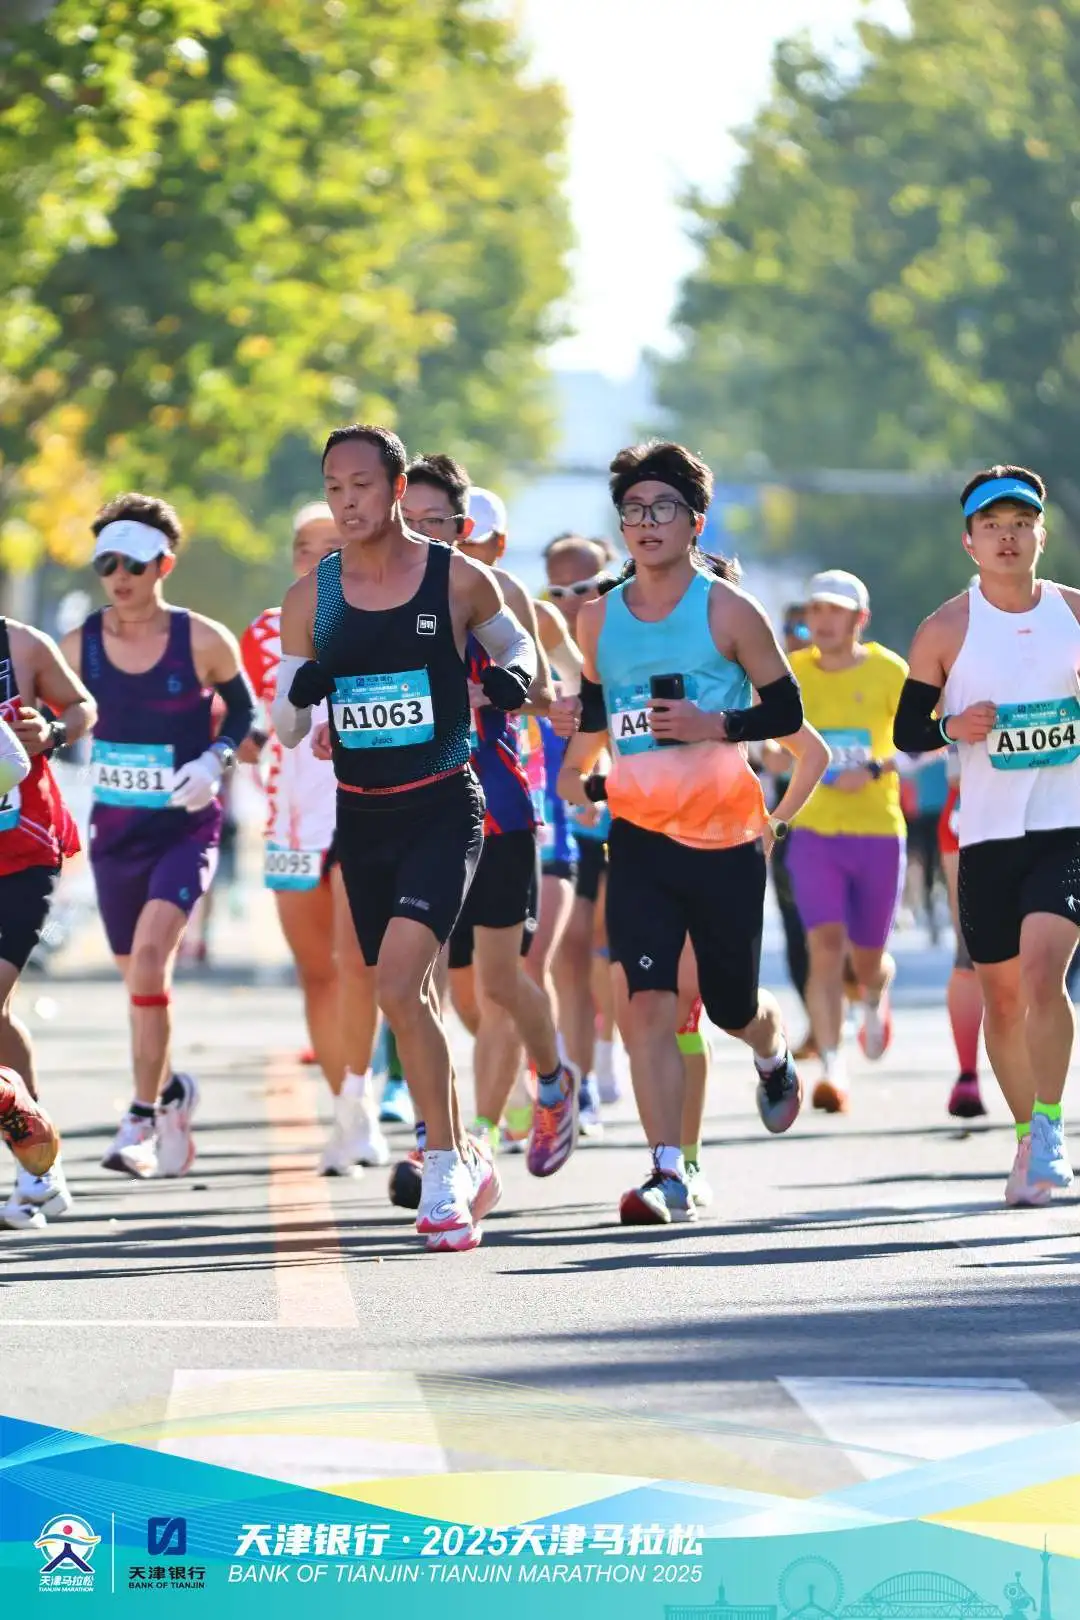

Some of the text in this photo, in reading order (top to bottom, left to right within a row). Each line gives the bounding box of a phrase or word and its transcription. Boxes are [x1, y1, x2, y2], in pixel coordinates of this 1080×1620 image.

[342, 700, 424, 729] A1063
[997, 723, 1076, 753] A1064
[99, 766, 164, 790] A4381
